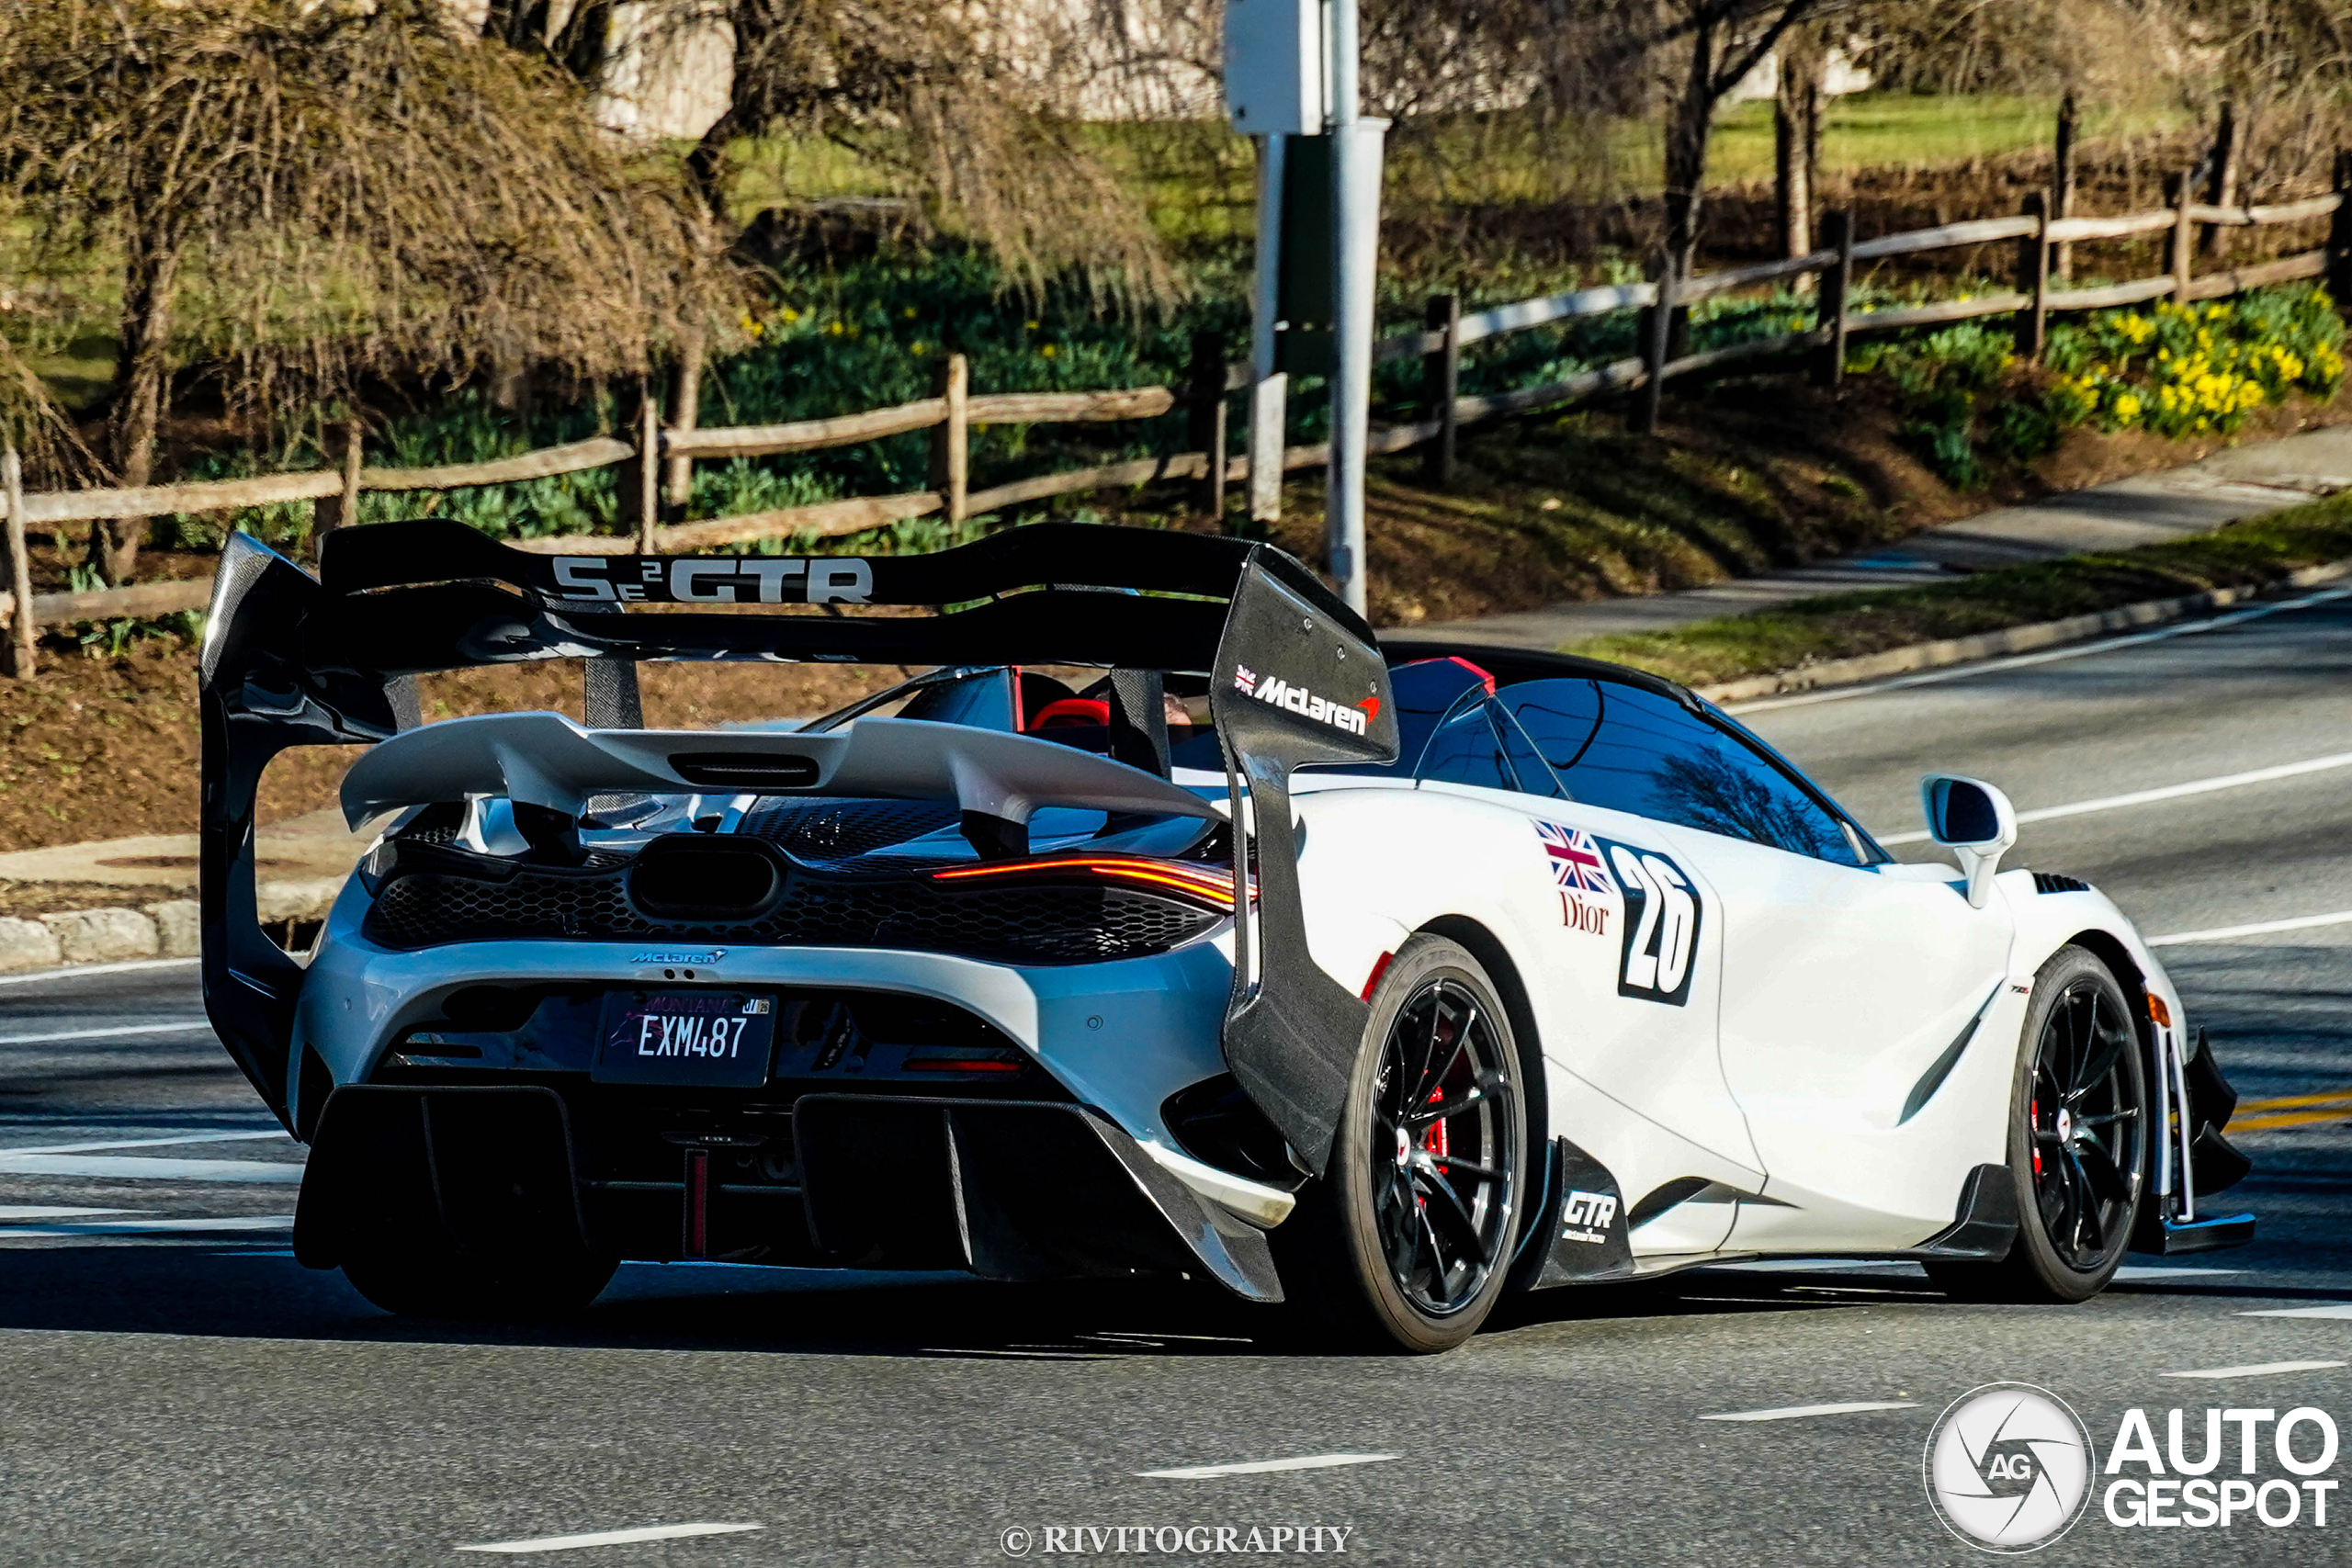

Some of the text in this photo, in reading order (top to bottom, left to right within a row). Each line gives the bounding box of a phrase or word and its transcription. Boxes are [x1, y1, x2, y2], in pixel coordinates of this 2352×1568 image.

[1254, 676, 1367, 736] McLaren
[1559, 891, 1610, 936] Dior
[1610, 845, 1695, 994] 26
[639, 1015, 748, 1057] EXM487
[1564, 1190, 1617, 1229] GTR
